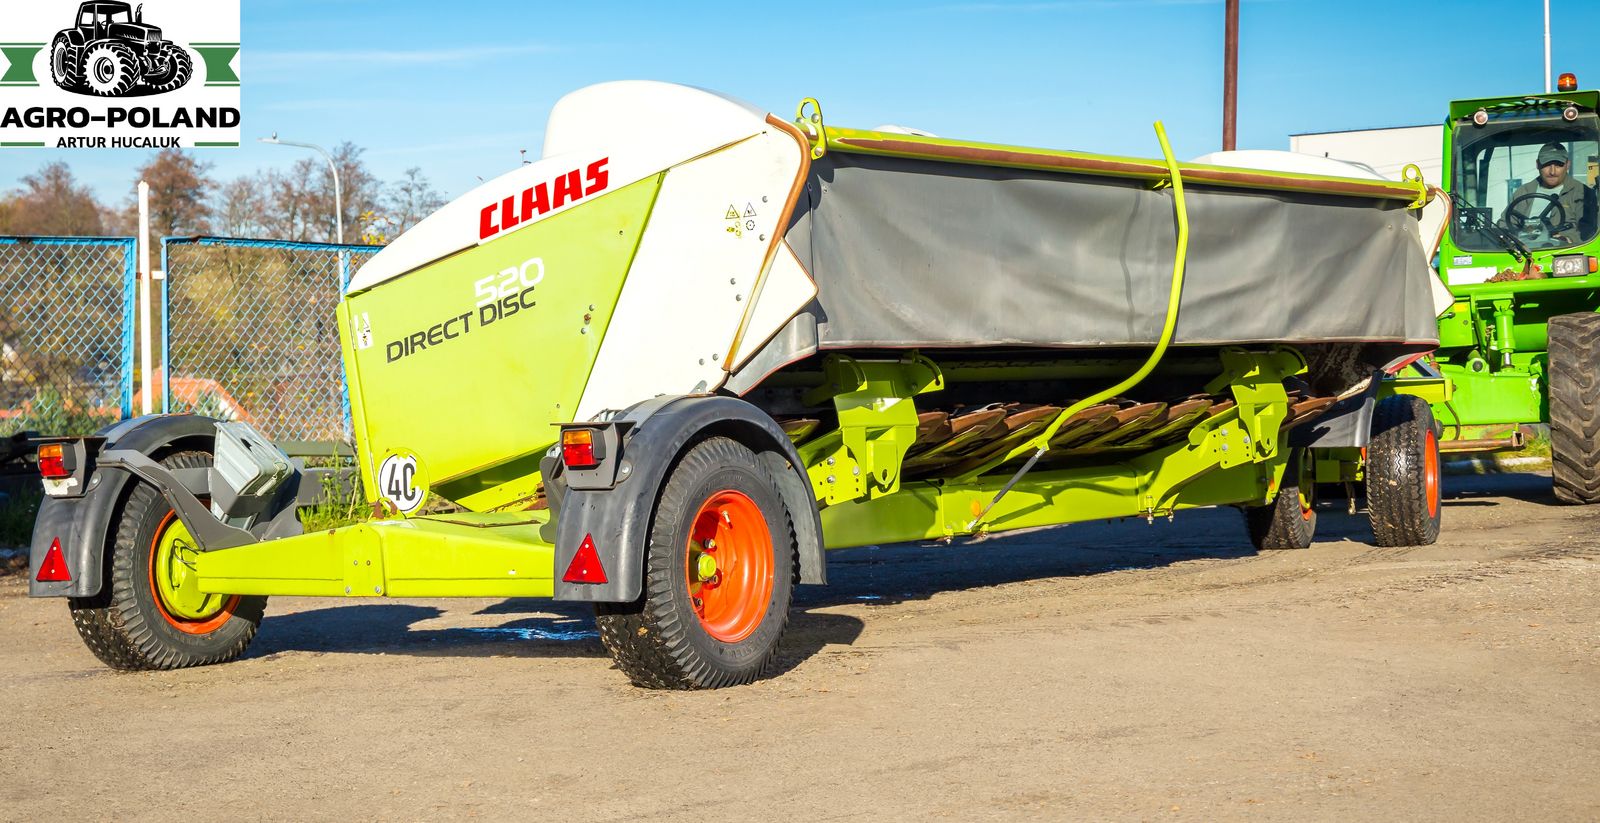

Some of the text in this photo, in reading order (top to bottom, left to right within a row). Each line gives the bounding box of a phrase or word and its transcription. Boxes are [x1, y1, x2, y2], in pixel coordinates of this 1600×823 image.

[479, 156, 609, 240] CLAAS
[474, 257, 545, 308] 520
[386, 286, 536, 363] DIRECT DISC
